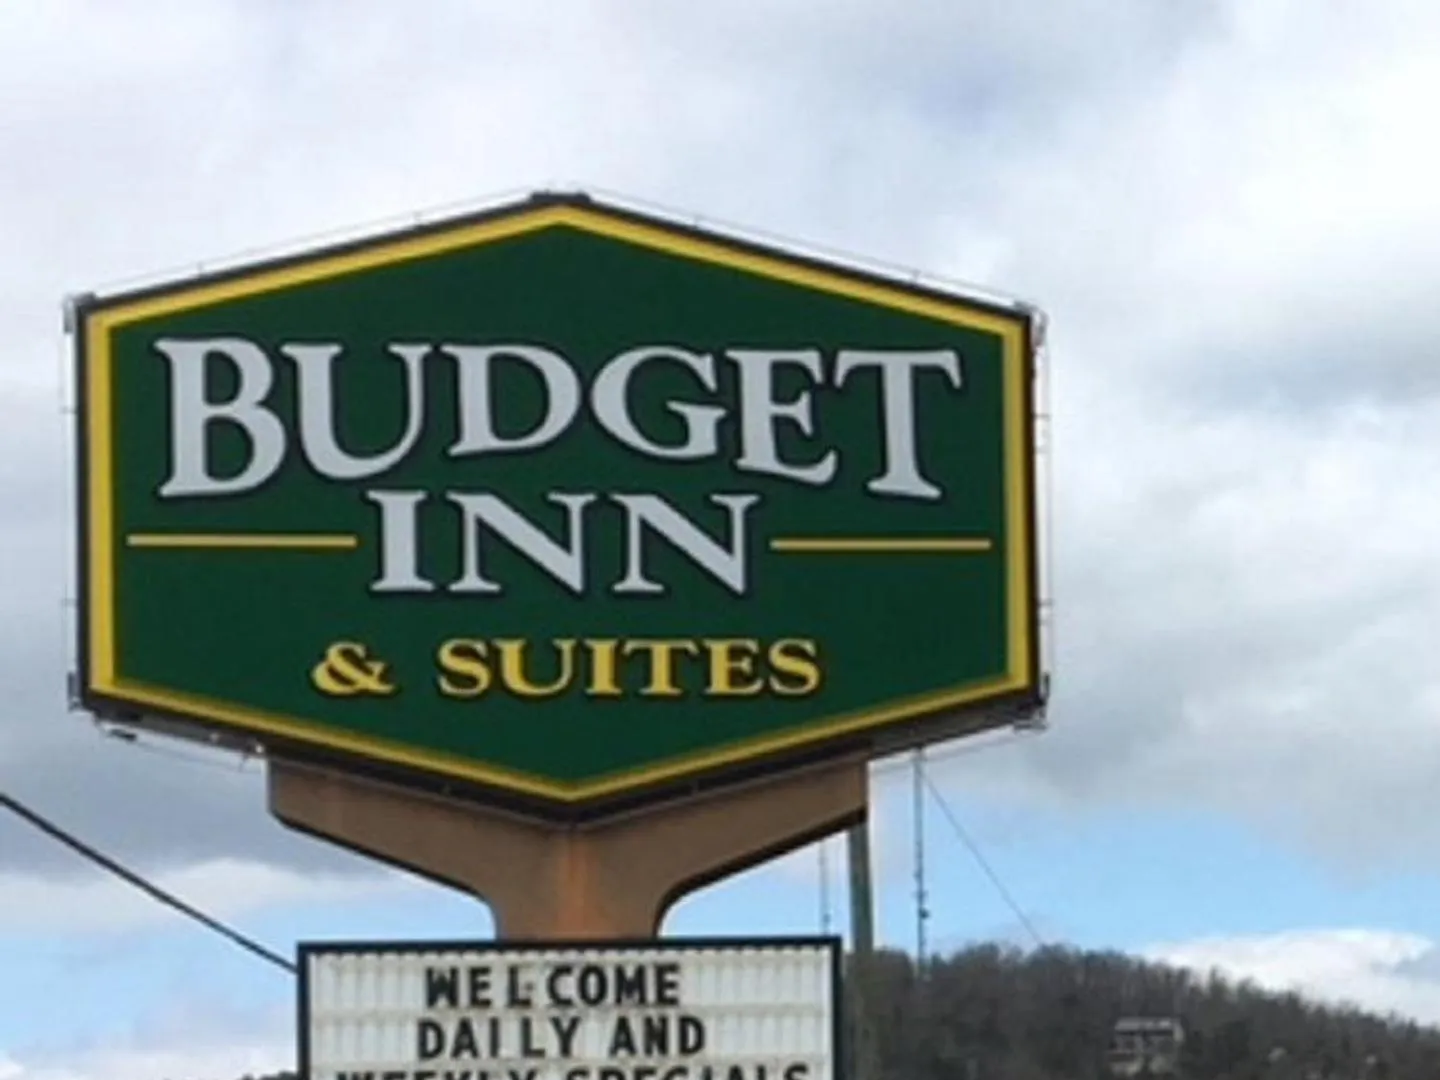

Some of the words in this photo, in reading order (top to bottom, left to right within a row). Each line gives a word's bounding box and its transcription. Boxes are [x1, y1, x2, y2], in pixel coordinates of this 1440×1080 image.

[156, 338, 961, 500] BUDGET
[368, 490, 758, 594] INN
[311, 643, 393, 695] &
[437, 639, 819, 695] SUITES
[425, 962, 681, 1009] WELCOME
[417, 1016, 580, 1061] DAILY
[609, 1014, 706, 1057] AND
